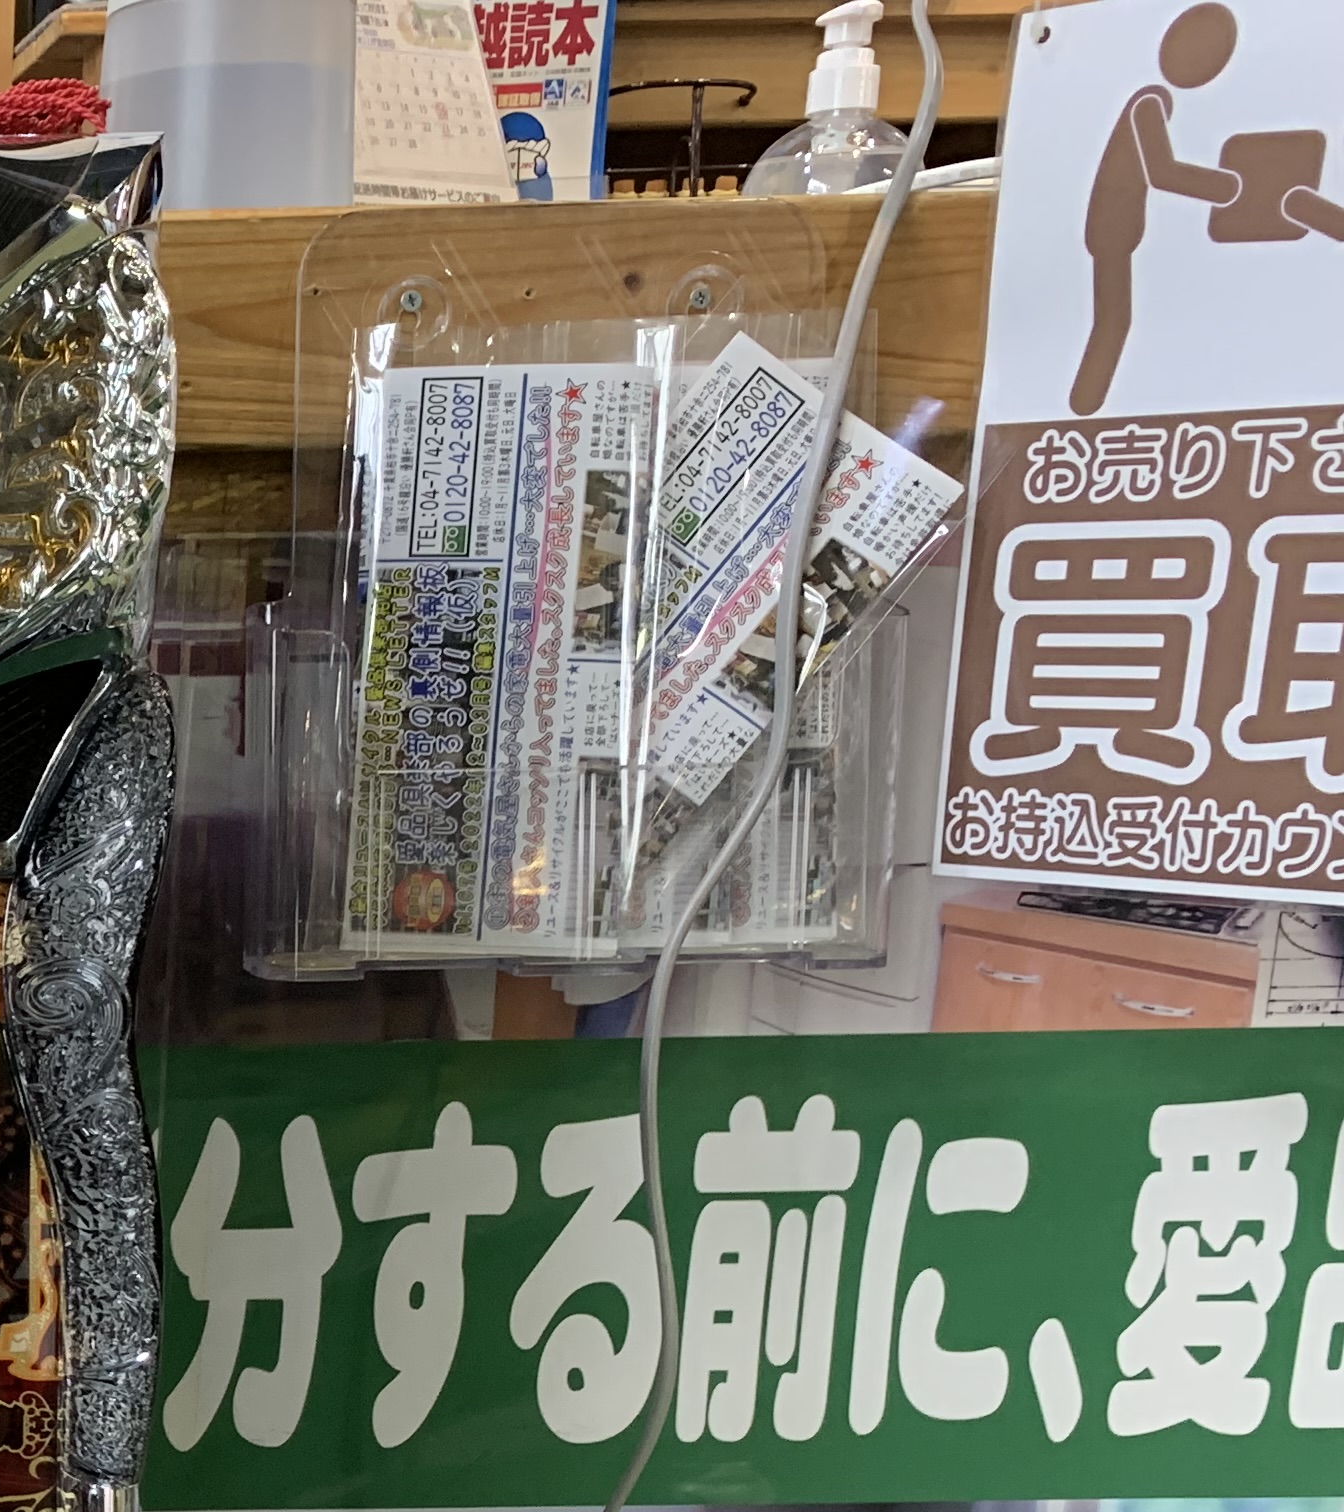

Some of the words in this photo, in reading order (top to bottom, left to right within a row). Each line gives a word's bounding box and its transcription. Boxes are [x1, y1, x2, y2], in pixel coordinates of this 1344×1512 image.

[443, 383, 475, 522] 0120-42-8087
[686, 389, 797, 515] 0120-42-8087
[152, 1092, 1344, 1452] 分する前に、愛
